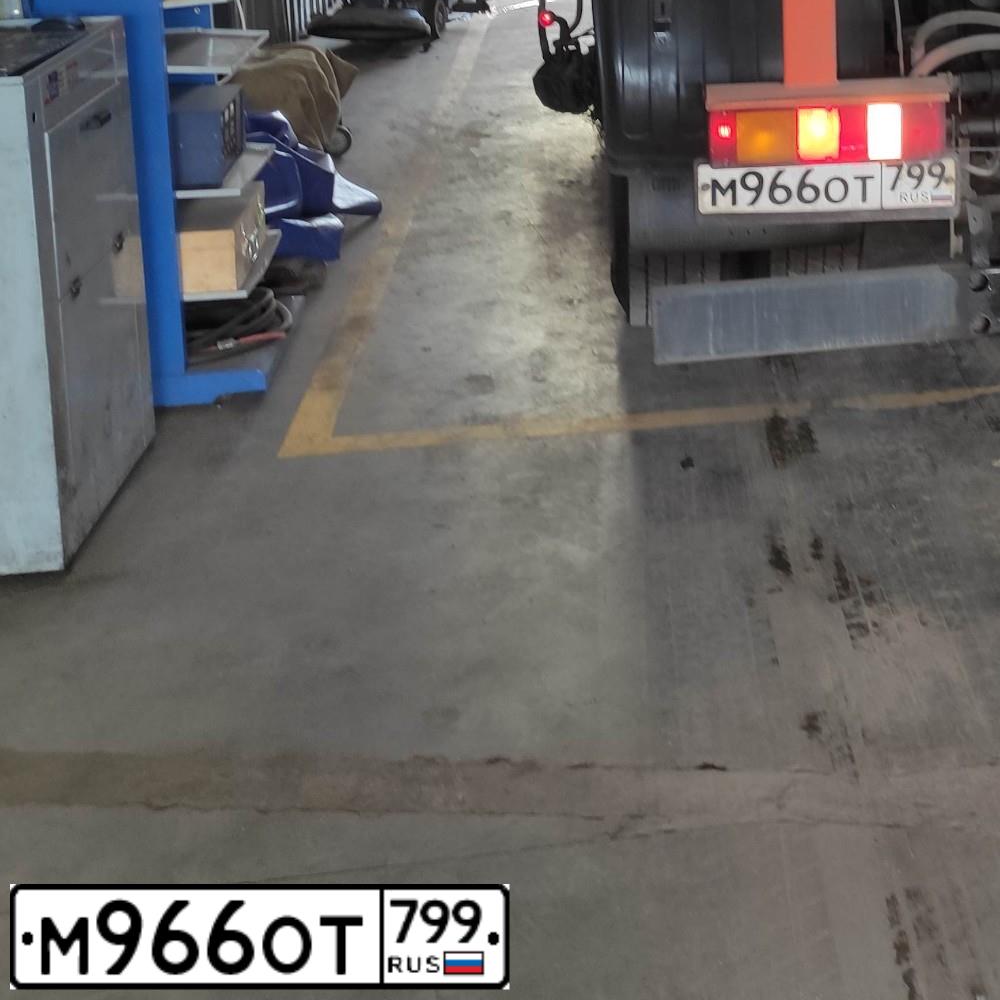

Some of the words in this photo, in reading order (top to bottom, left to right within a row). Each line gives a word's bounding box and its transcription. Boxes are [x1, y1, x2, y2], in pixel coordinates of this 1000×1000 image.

[710, 168, 875, 207] М966ОТ
[889, 160, 946, 192] 799
[899, 191, 930, 204] RUS
